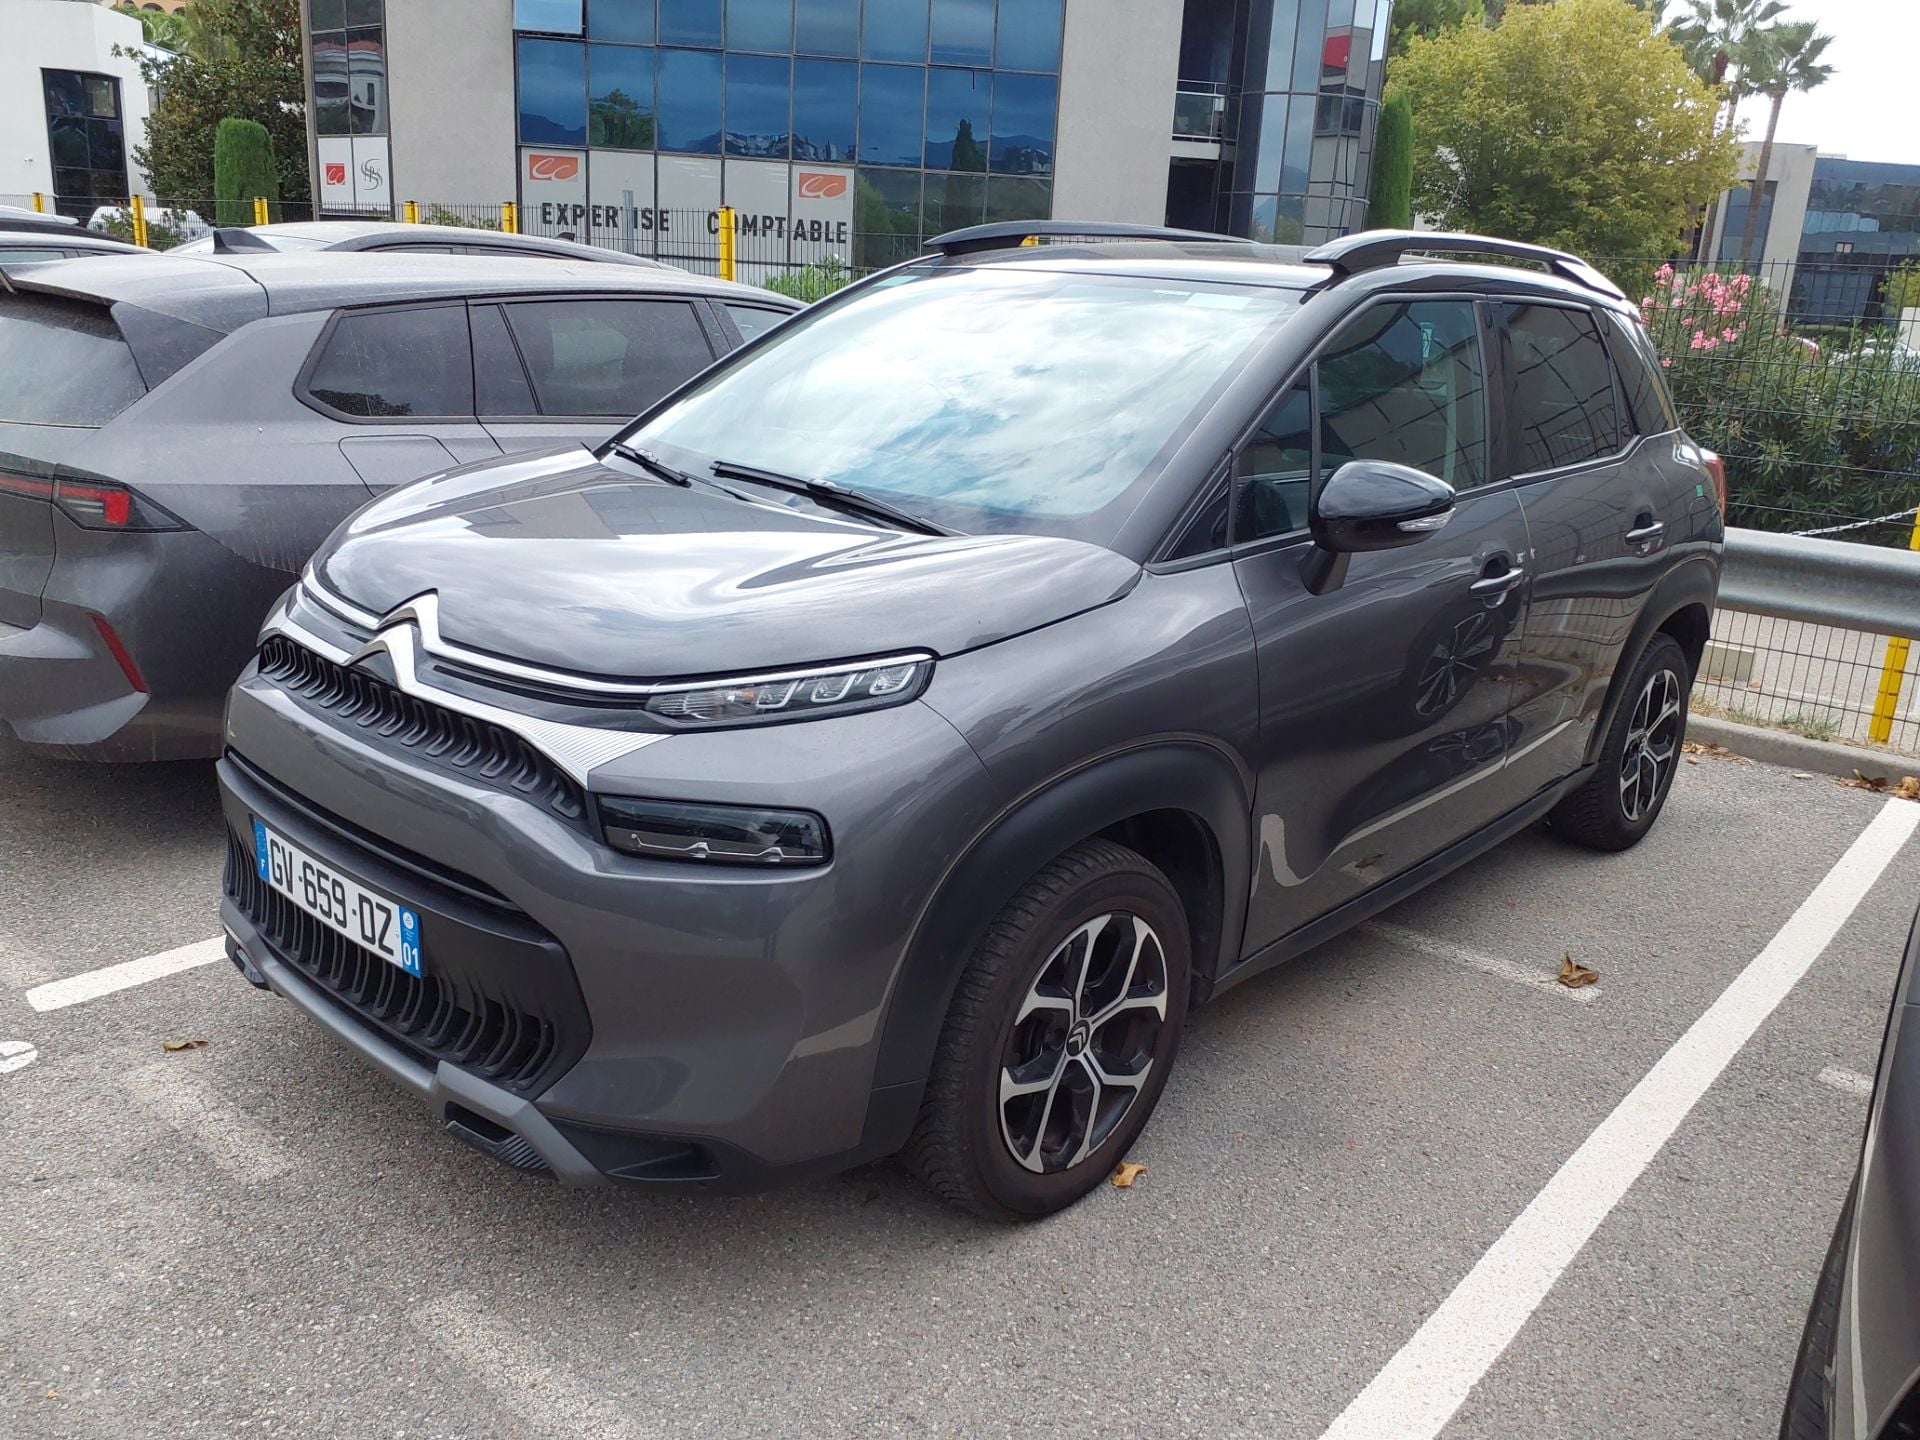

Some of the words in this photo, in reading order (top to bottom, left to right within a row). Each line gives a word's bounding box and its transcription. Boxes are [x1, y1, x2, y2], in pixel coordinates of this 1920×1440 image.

[542, 202, 669, 232] EXPERISE
[707, 211, 847, 244] CMPTABLE
[402, 942, 419, 971] 01
